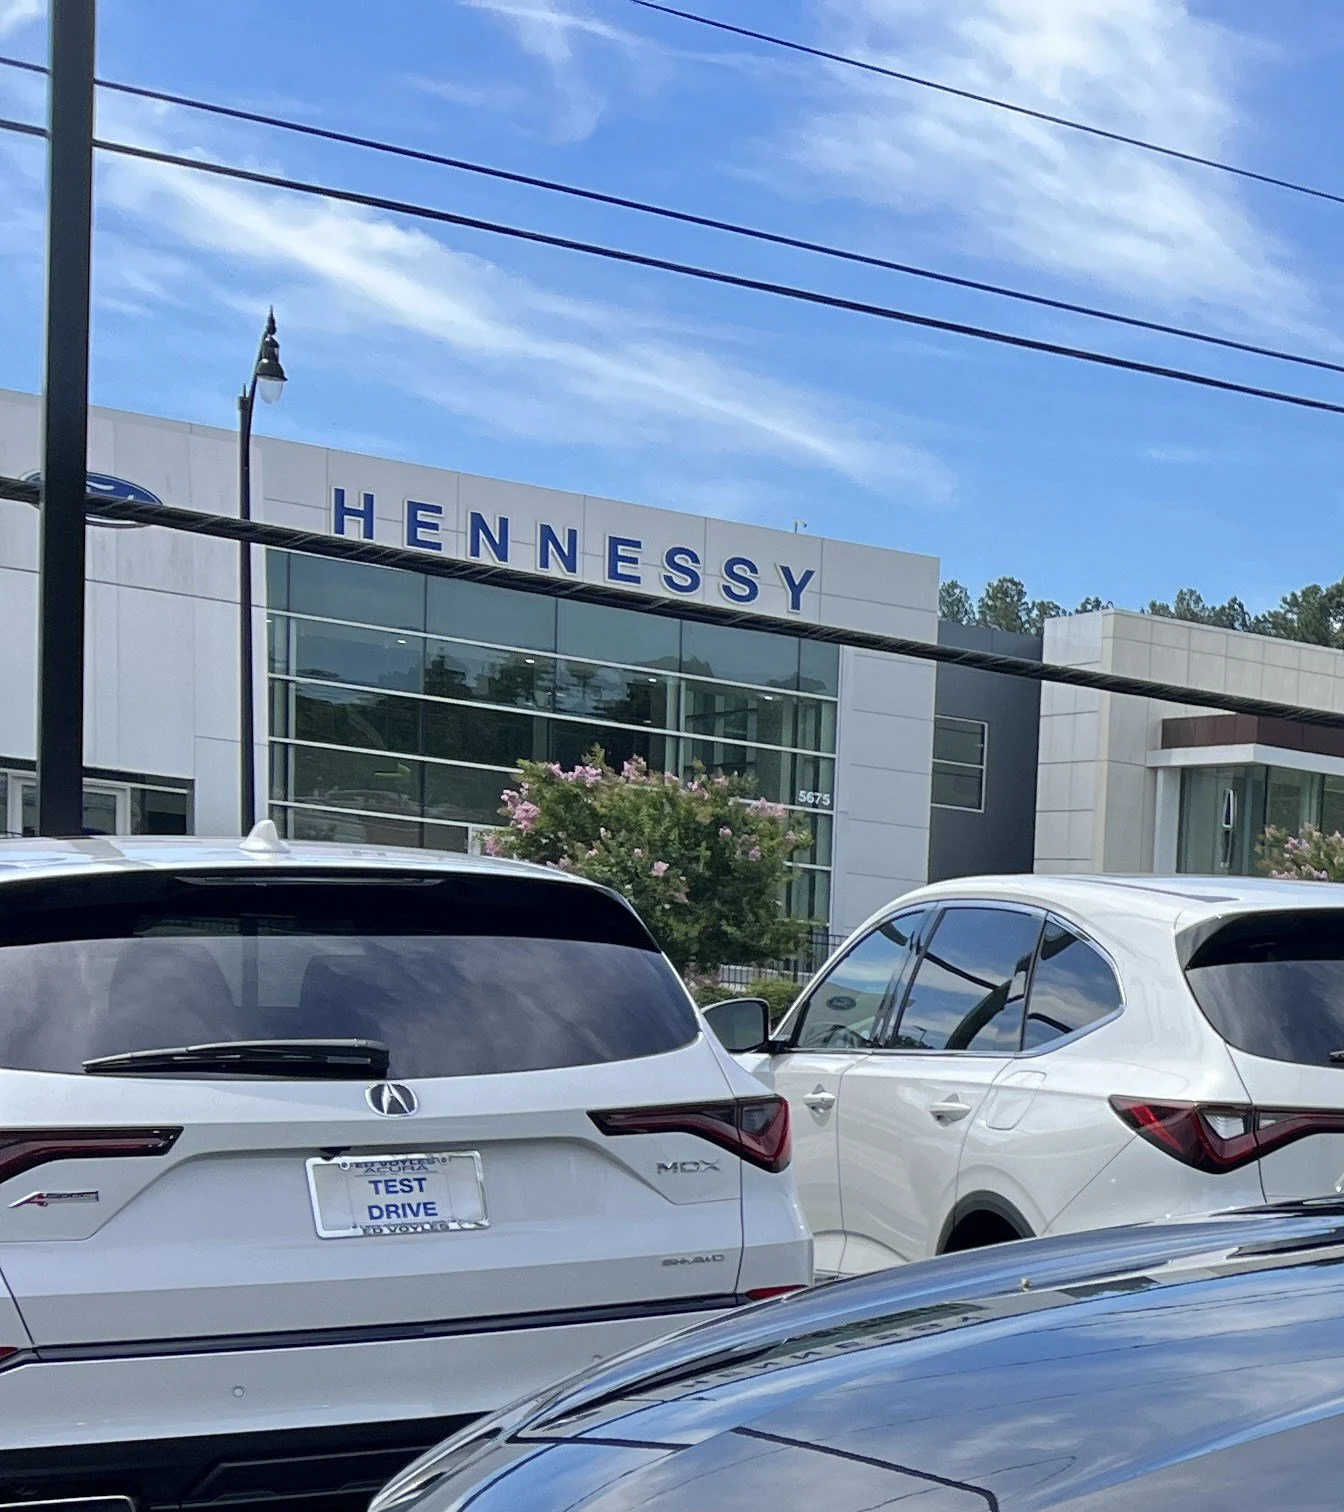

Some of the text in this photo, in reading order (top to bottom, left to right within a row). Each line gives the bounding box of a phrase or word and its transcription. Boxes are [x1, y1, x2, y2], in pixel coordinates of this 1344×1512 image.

[332, 487, 816, 612] HENNESSY
[797, 789, 831, 806] 5675
[364, 1165, 430, 1174] ACURA
[368, 1177, 427, 1196] TEST
[367, 1202, 438, 1221] DRIVE
